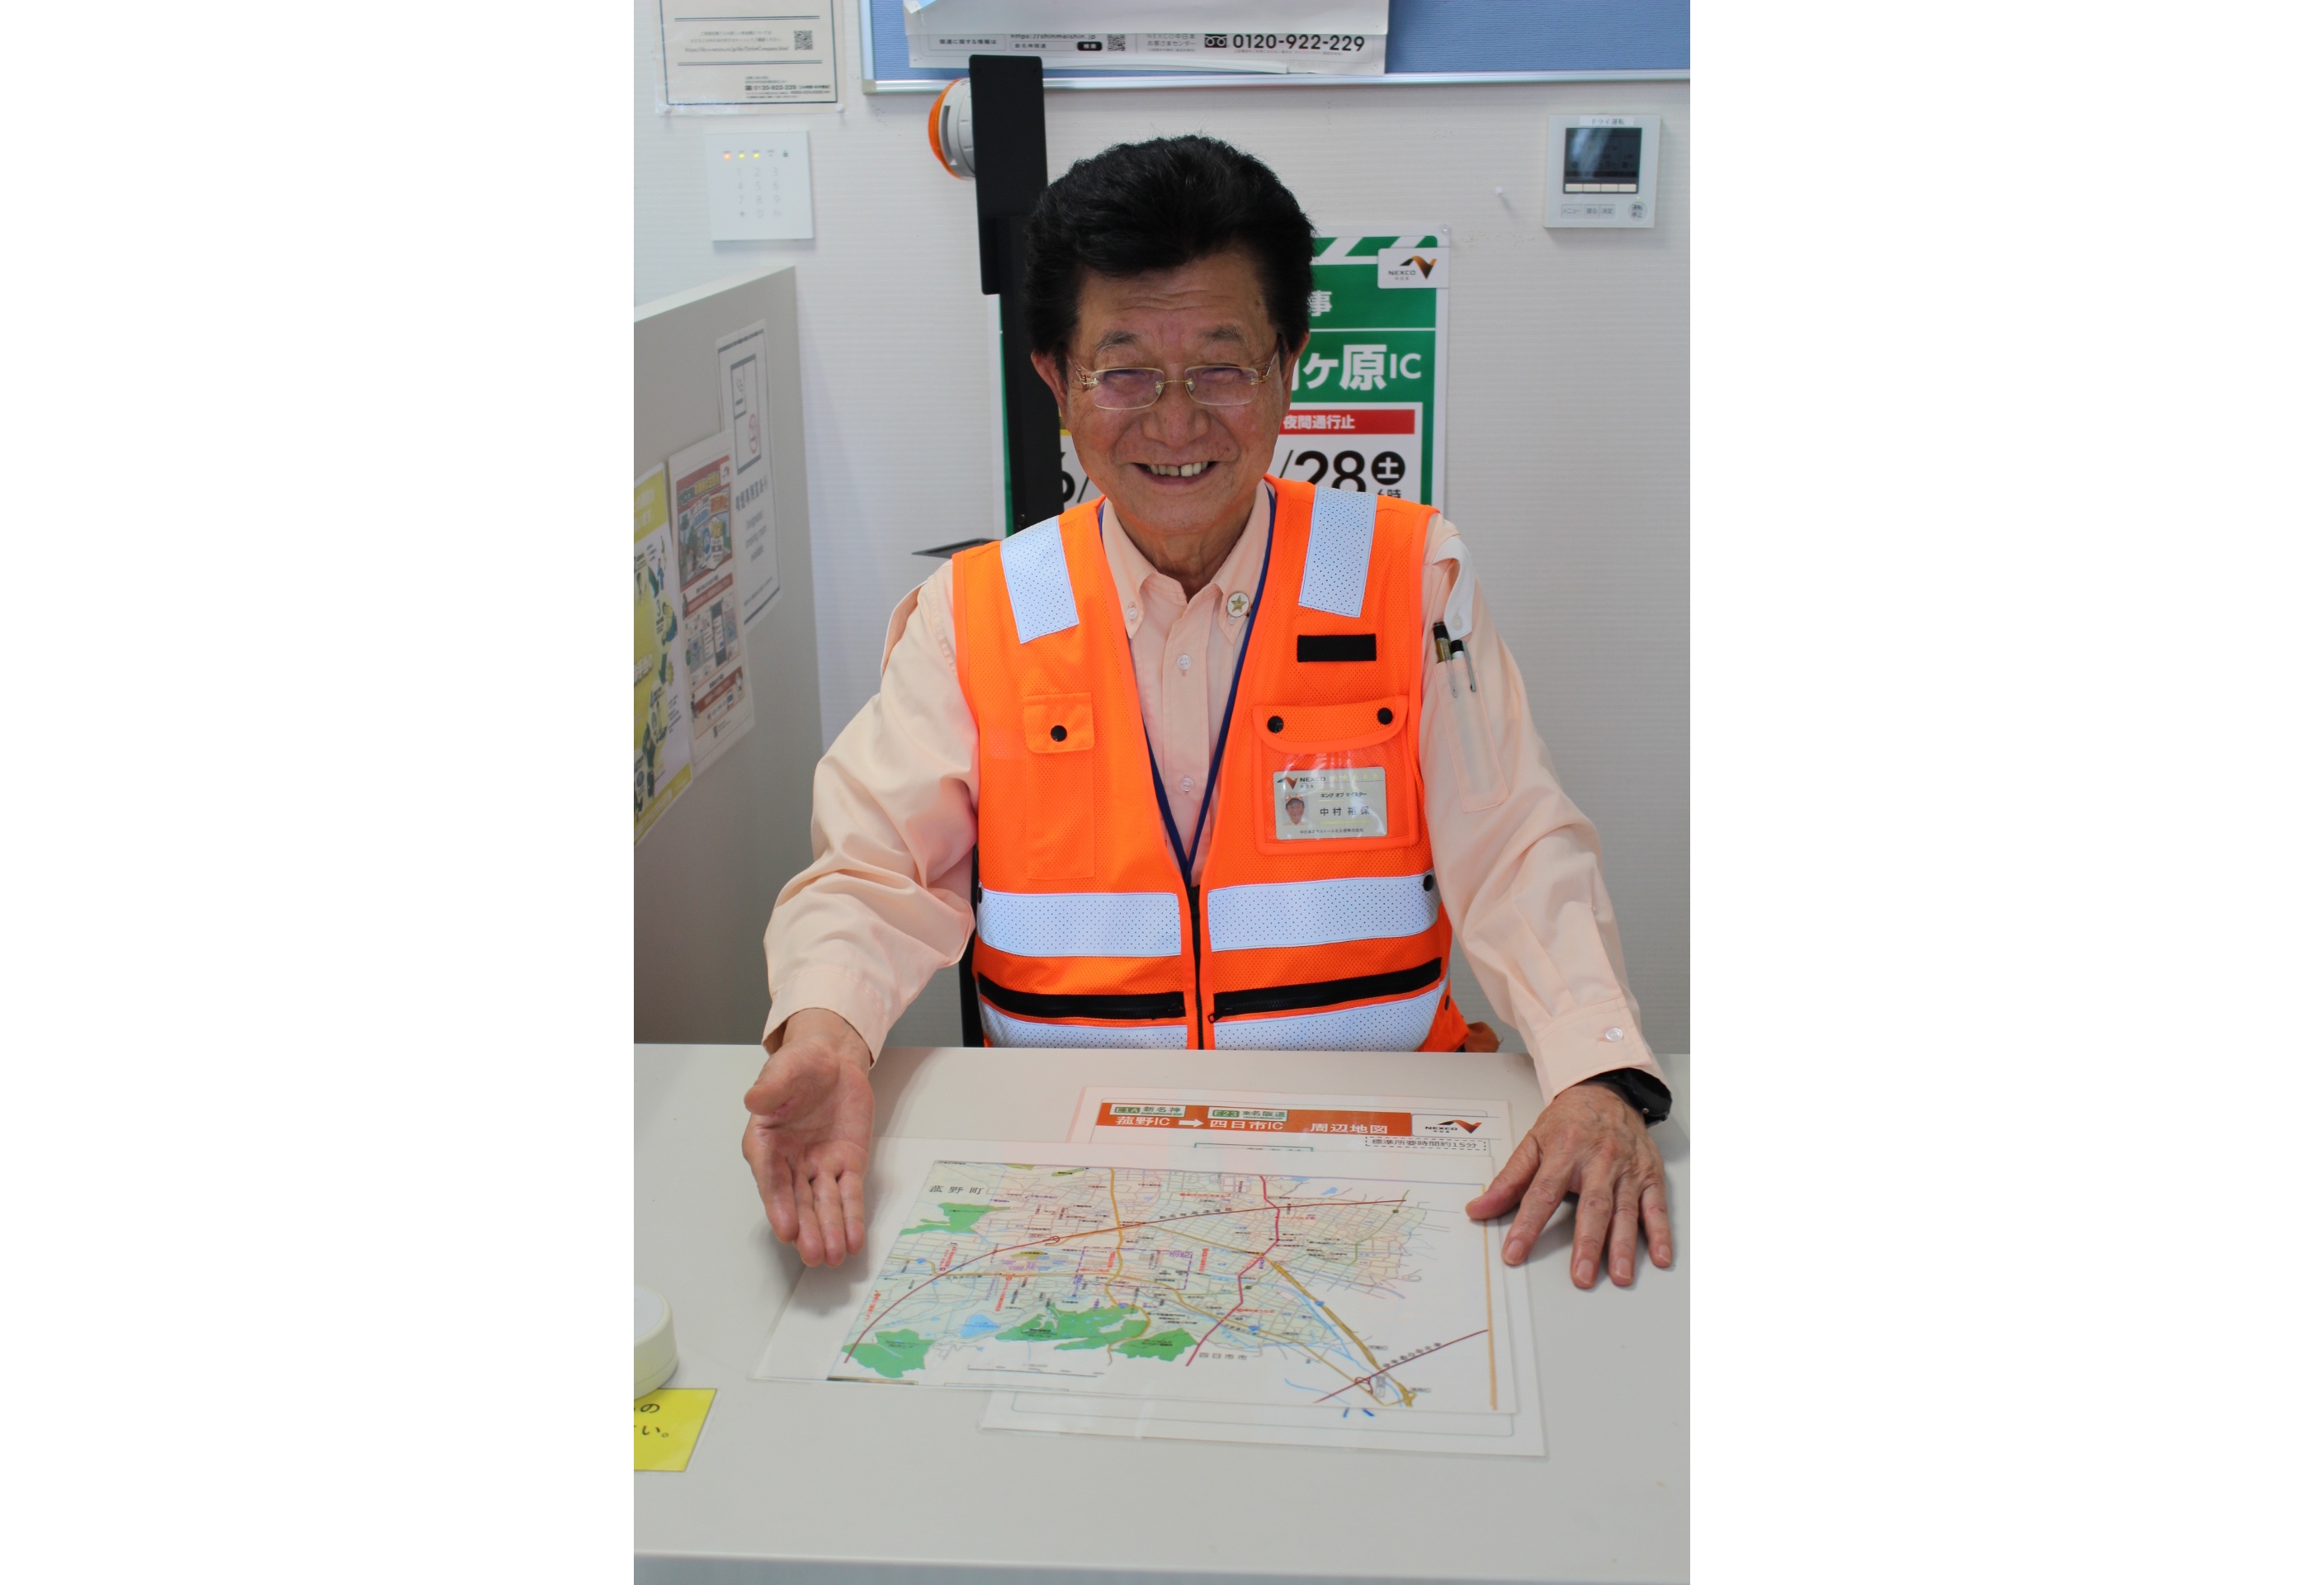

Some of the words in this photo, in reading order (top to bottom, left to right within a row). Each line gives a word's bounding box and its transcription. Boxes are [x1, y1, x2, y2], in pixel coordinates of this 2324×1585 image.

[1232, 34, 1365, 52] 0120-922-229
[1292, 343, 1422, 392] ヶ原IC
[1282, 414, 1356, 430] 夜間通行止
[1242, 1110, 1286, 1119] 東名阪道
[1115, 1115, 1170, 1126] 菰野IC
[1209, 1119, 1283, 1130] 四日市IC
[1310, 1123, 1388, 1134] 周辺地図
[1371, 1138, 1477, 1148] 標準所要時間約15分
[928, 1185, 985, 1195] 菰野町
[1198, 1352, 1247, 1360] 四日市市
